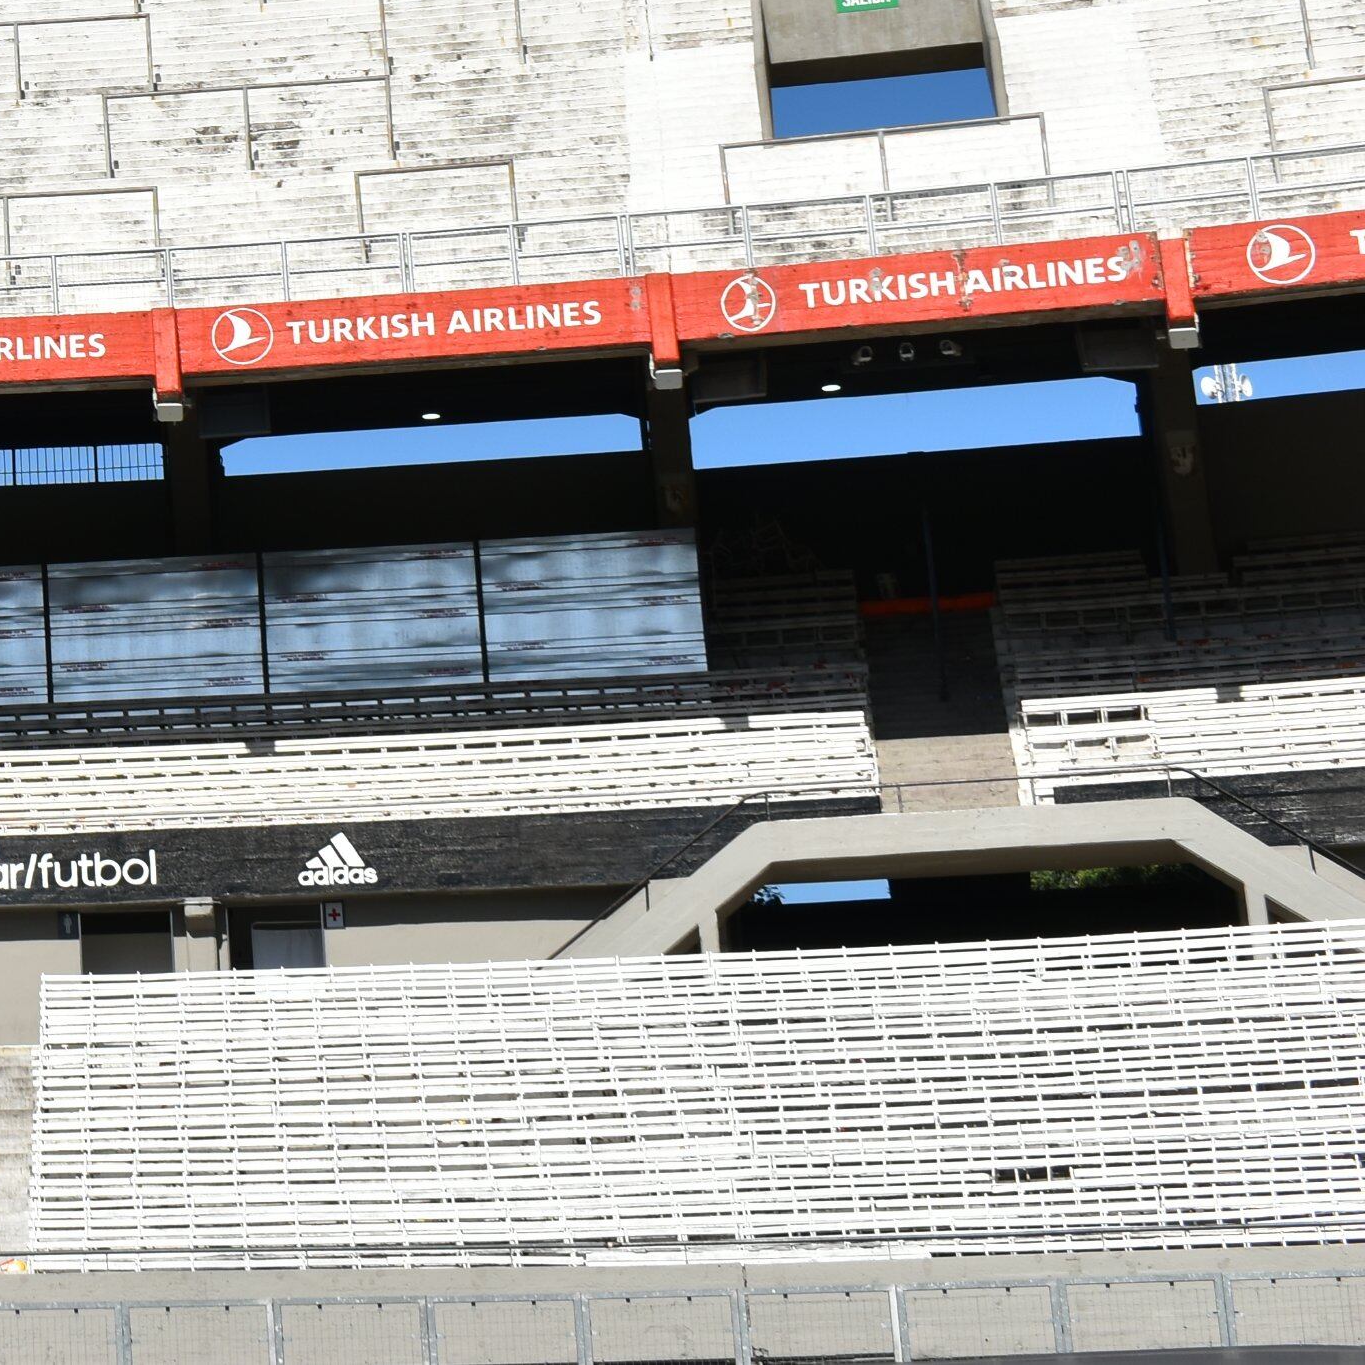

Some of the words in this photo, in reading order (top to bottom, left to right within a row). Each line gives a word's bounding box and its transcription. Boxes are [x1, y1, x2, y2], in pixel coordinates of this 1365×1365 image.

[798, 270, 956, 309] TURKISH
[964, 256, 1127, 294] AIRLINES
[285, 312, 436, 345] TURKISH
[446, 300, 602, 335] AIRLINES
[297, 865, 379, 887] adidas
